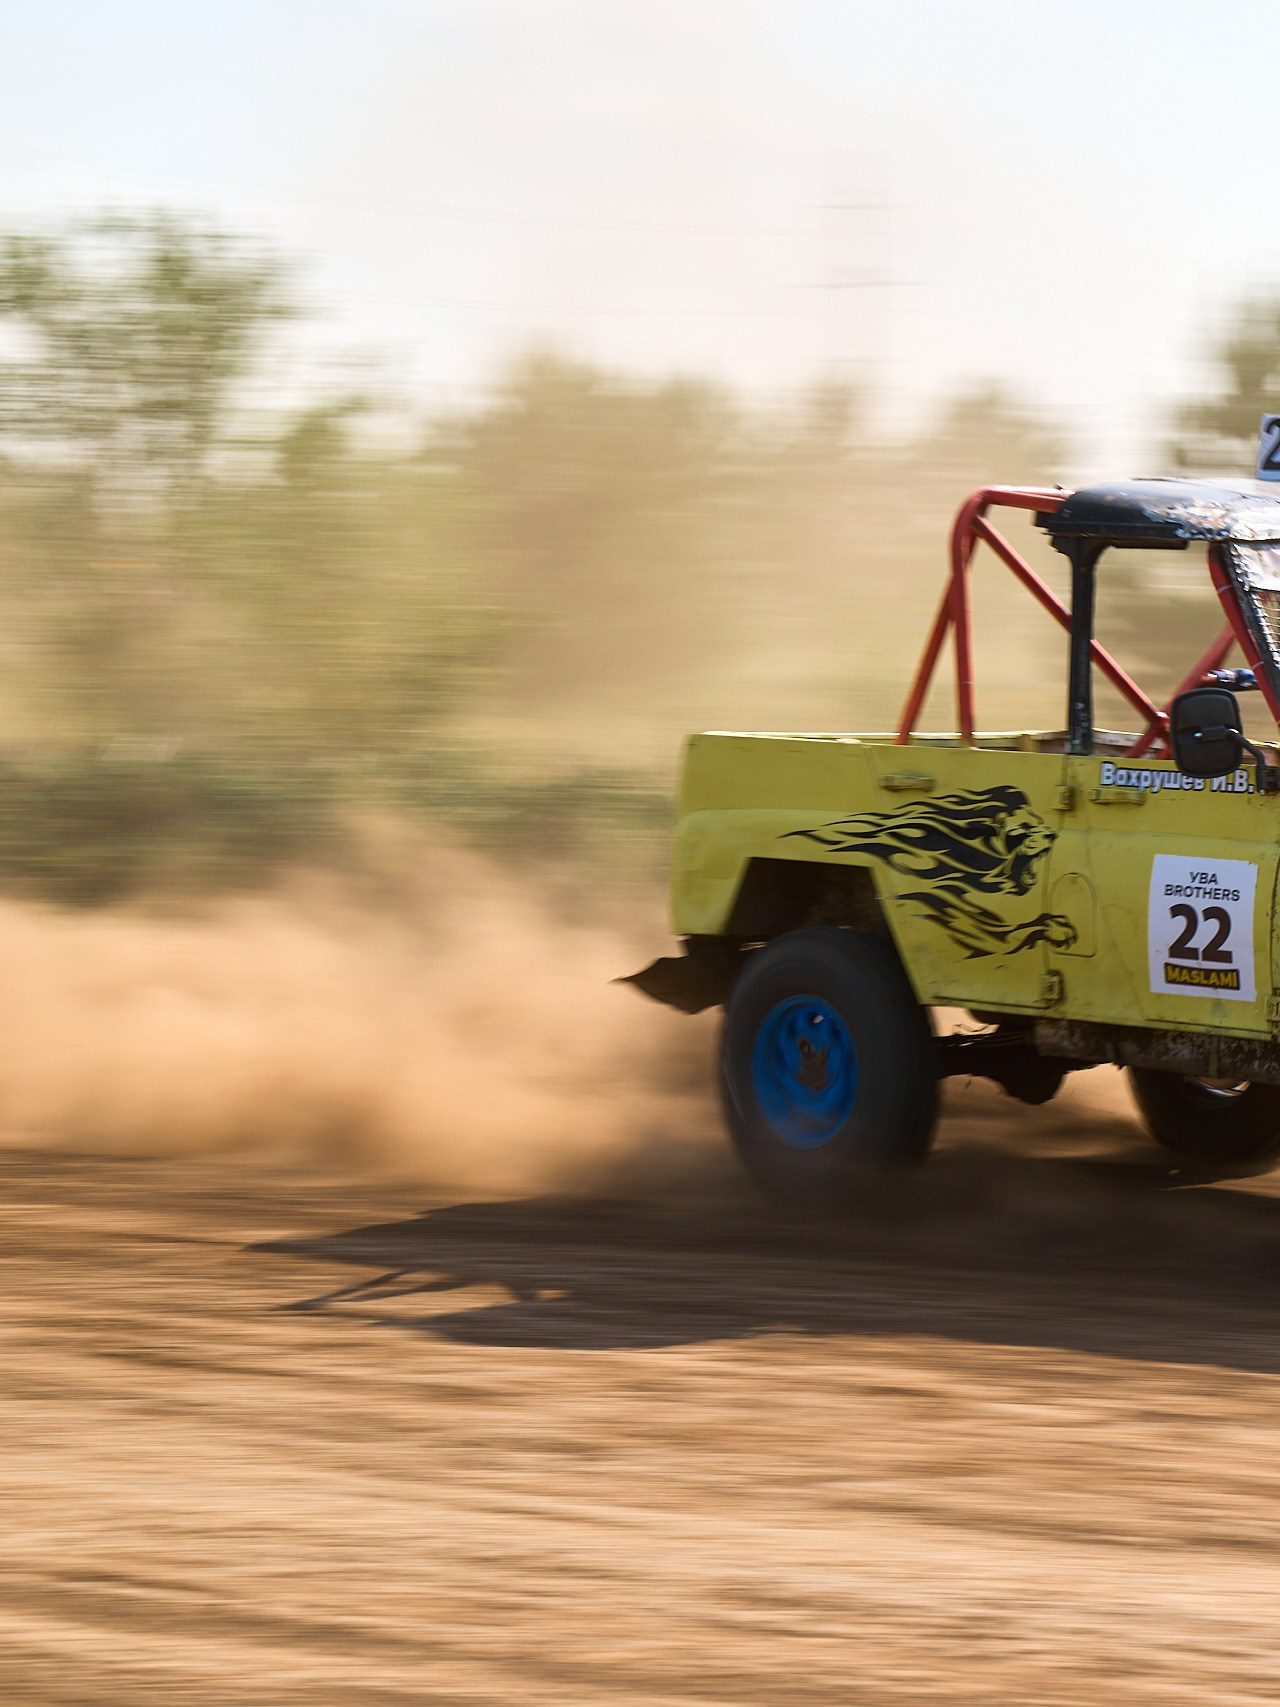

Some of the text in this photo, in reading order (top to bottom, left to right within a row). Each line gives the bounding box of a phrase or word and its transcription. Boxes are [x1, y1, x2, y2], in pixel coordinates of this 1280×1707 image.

[1100, 762, 1206, 792] Вахрушев
[1163, 884, 1240, 901] BROTHERS
[1168, 903, 1233, 964] 22
[1166, 965, 1238, 988] MASLAMI
